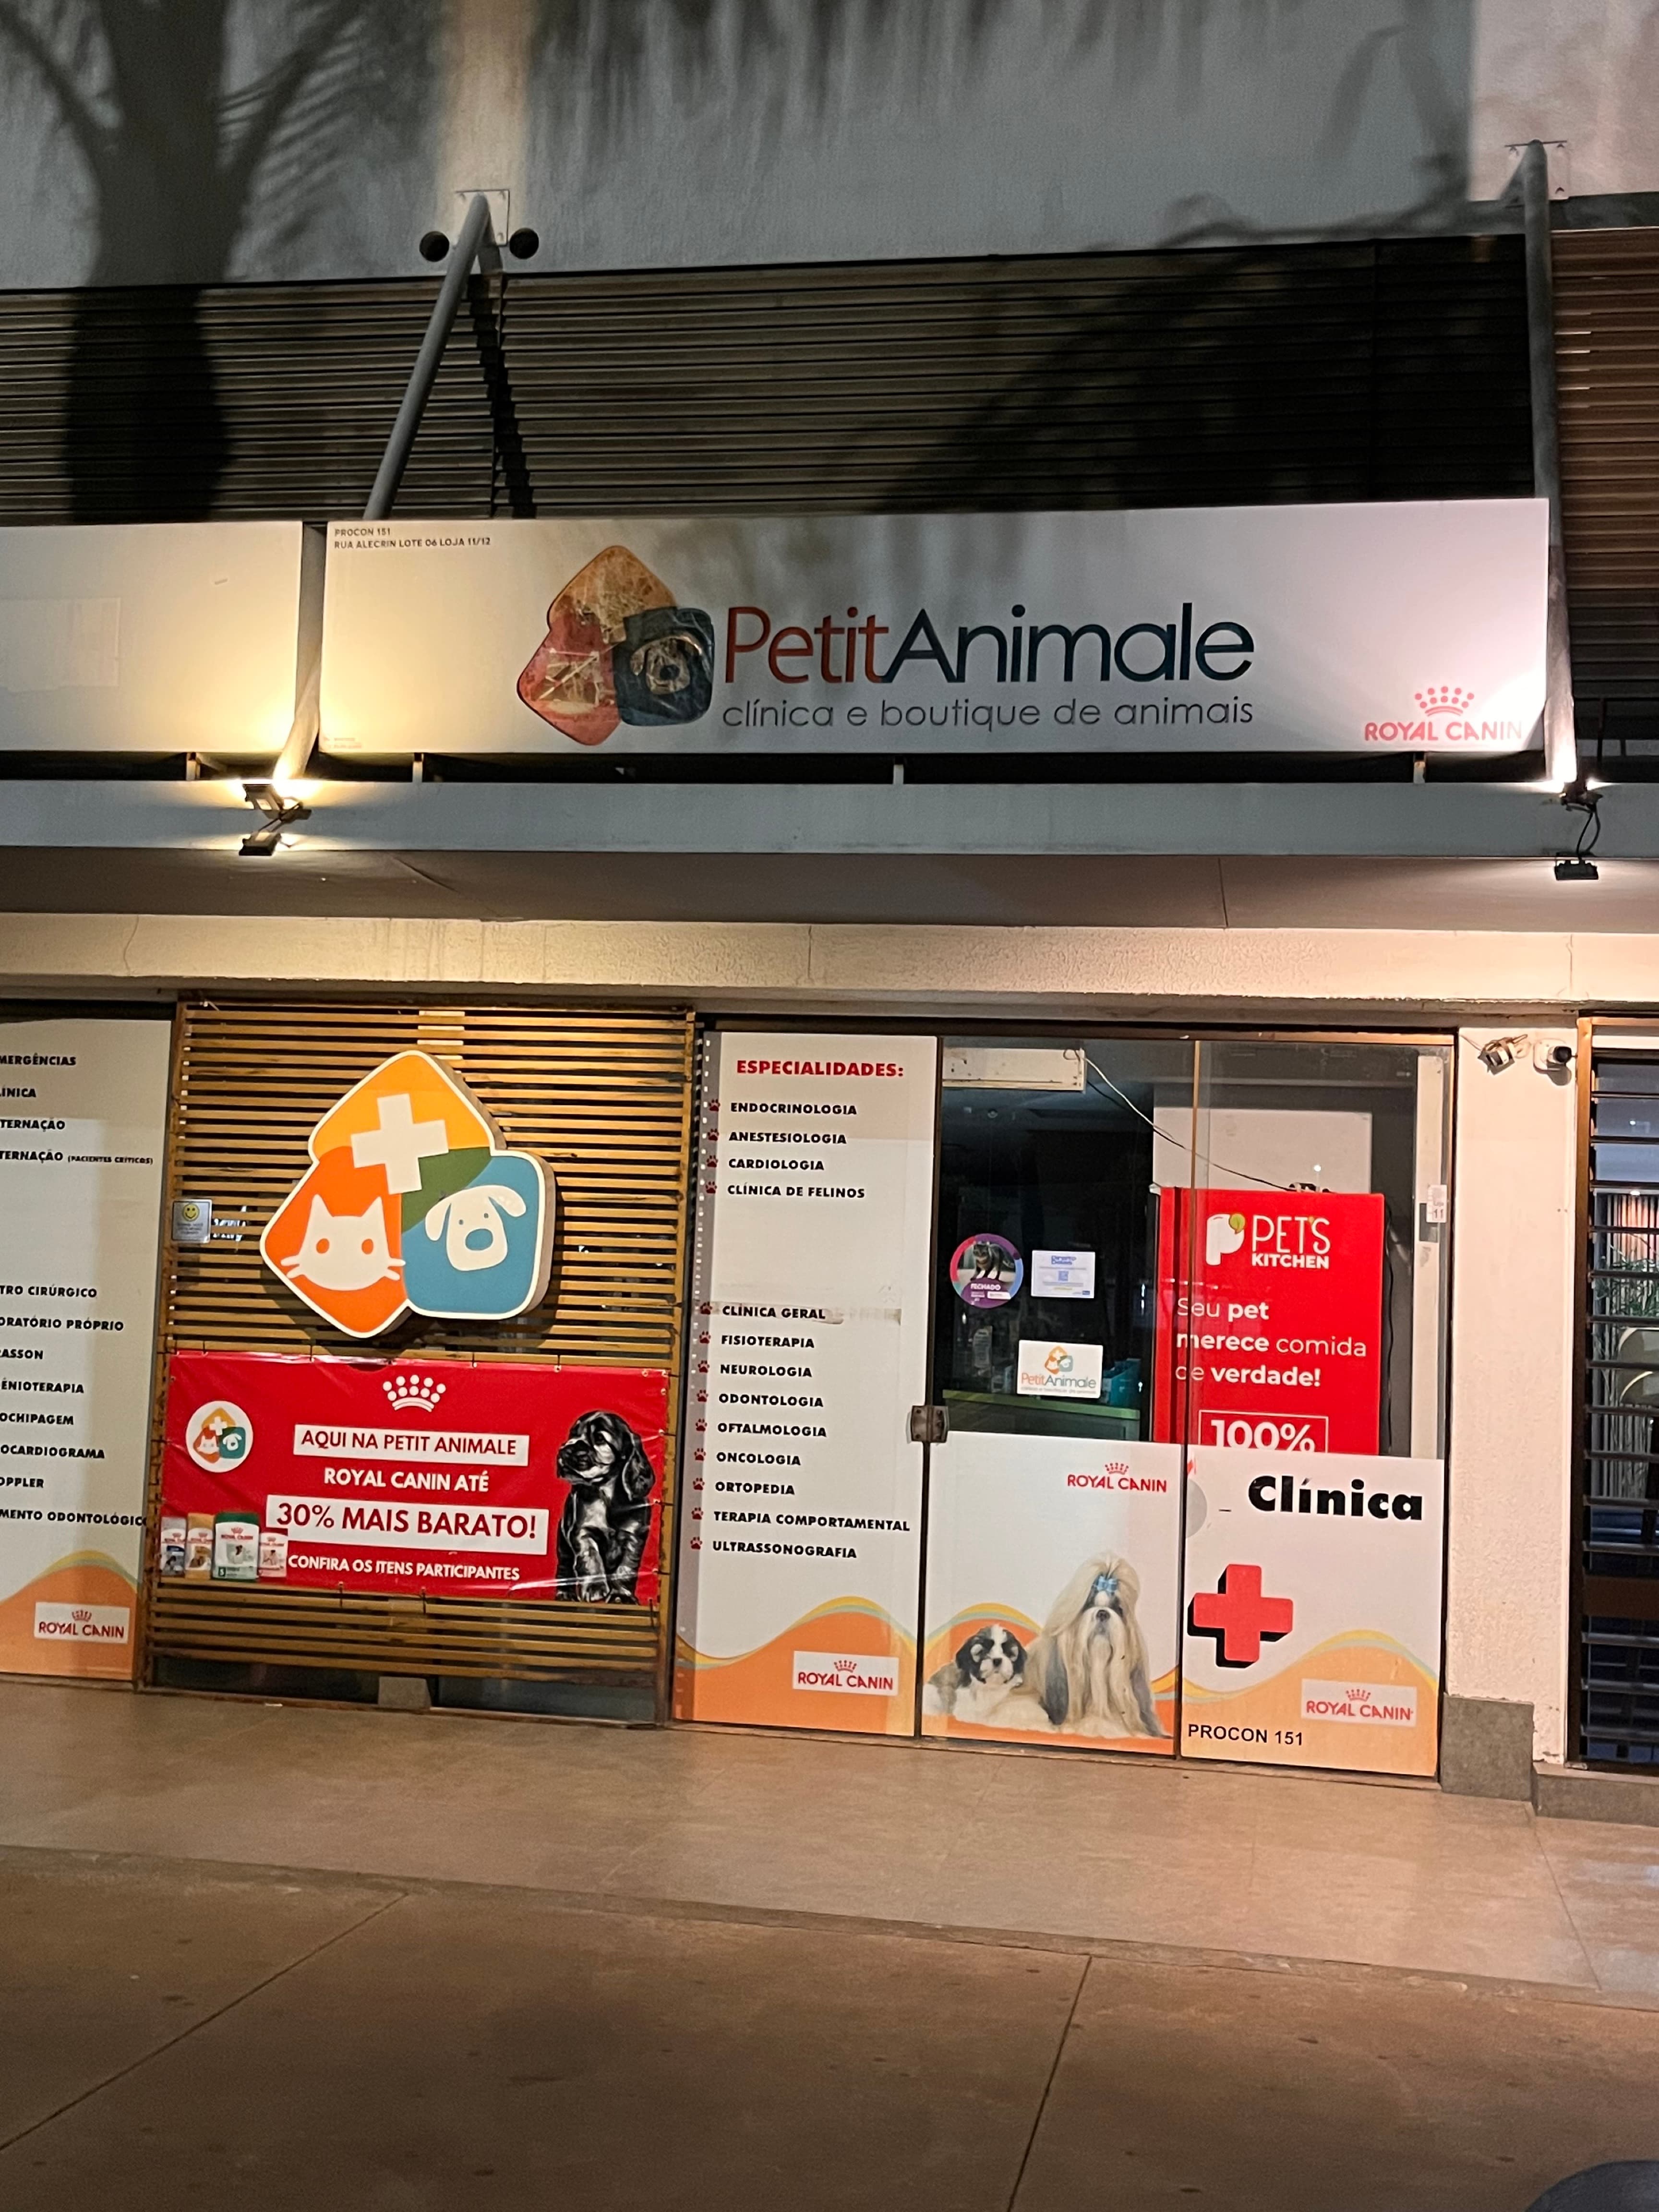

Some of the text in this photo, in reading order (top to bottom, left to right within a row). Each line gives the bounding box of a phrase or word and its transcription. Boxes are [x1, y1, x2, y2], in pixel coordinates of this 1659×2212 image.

[334, 528, 391, 537] PROCON 151
[334, 541, 354, 549] RUA
[399, 538, 422, 547] LOTE
[439, 537, 465, 546] LOJA
[725, 602, 1254, 684] PetitAnimale
[722, 696, 1253, 732] clínica e boutique de animais
[1364, 721, 1522, 741] ROYAL CANIN
[737, 1059, 904, 1077] ESPECIALIDADES:
[0, 1085, 36, 1098] ÍNICA
[731, 1102, 857, 1115] ENDOCRINOLOGIA
[729, 1131, 847, 1144] ANESTESIOLOGIA
[729, 1158, 825, 1171] CARDIOLOGIA
[727, 1182, 865, 1198] CLÍNICA DE FELINOS
[1251, 1253, 1330, 1270] KITCHEN
[28, 1284, 97, 1298] CIRÚRGICO
[722, 1302, 826, 1320] CLÍNICA GERAL
[1177, 1298, 1270, 1322] Seu pet
[66, 1317, 124, 1331] PRÓPRIO
[721, 1334, 815, 1348] FISIOTERAPIA
[1176, 1333, 1367, 1357] merece comida
[0, 1348, 44, 1359] ASSON
[720, 1364, 813, 1378] NEUROLOGIA
[1210, 1364, 1322, 1387] verdade!
[719, 1393, 824, 1407] ODONTOLOGIA
[717, 1422, 827, 1437] OFTALMOLOGIA
[1210, 1419, 1316, 1452] 100%
[0, 1444, 105, 1459] OCARDIOGRAMA
[301, 1430, 517, 1455] AQUI NA PETIT ANIMALE
[716, 1452, 801, 1466] ONCOLOGIA
[324, 1467, 489, 1492] ROYAL CANIN ATÉ
[715, 1481, 795, 1495] ORTOPEDIA
[1067, 1474, 1167, 1493] ROYAL CANIN
[1248, 1475, 1423, 1521] Clínica
[276, 1502, 536, 1539] 30% MAIS BARATO!
[714, 1511, 911, 1531] TERAPIA COMPORTAMENTAL
[712, 1540, 857, 1558] ULTRASSONOGRAFIA
[288, 1554, 520, 1581] CONFIRA OS ITENS PARTICIPANTES
[38, 1621, 124, 1638] ROYAL CANIN
[797, 1671, 893, 1690] ROYAL CANIN
[1306, 1700, 1411, 1721] ROYAL CANIN
[1188, 1723, 1303, 1746] PROCON 151
